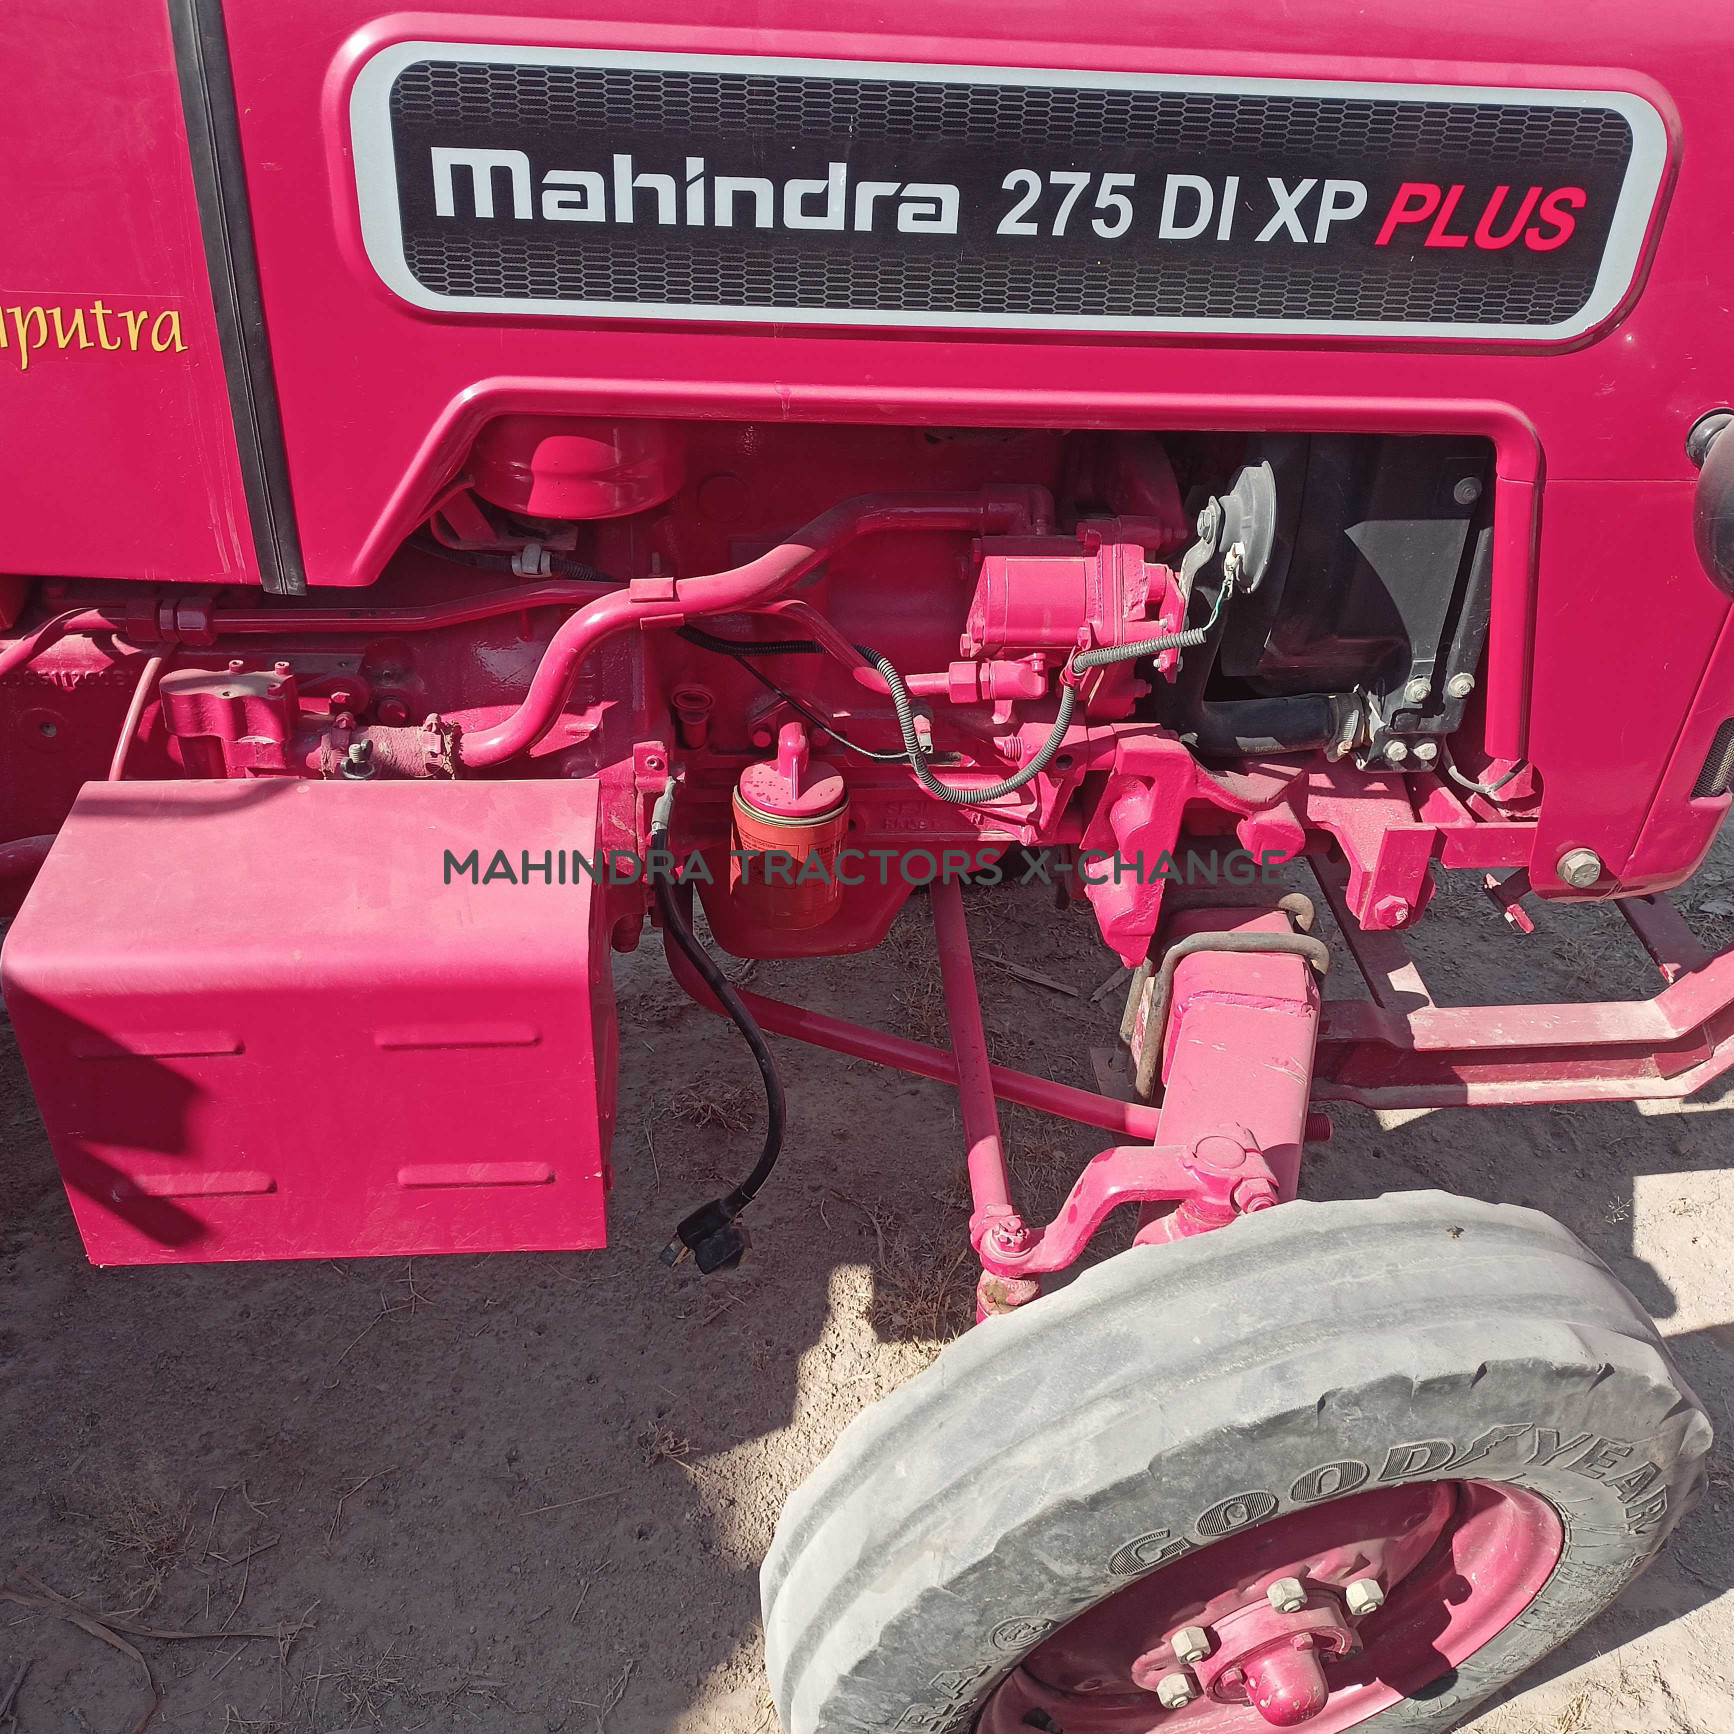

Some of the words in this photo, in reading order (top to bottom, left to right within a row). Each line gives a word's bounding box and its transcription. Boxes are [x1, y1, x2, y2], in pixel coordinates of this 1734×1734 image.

[996, 168, 1136, 239] 275
[1158, 173, 1240, 241] DI
[1254, 177, 1368, 244] XP
[1374, 182, 1587, 252] PLUS
